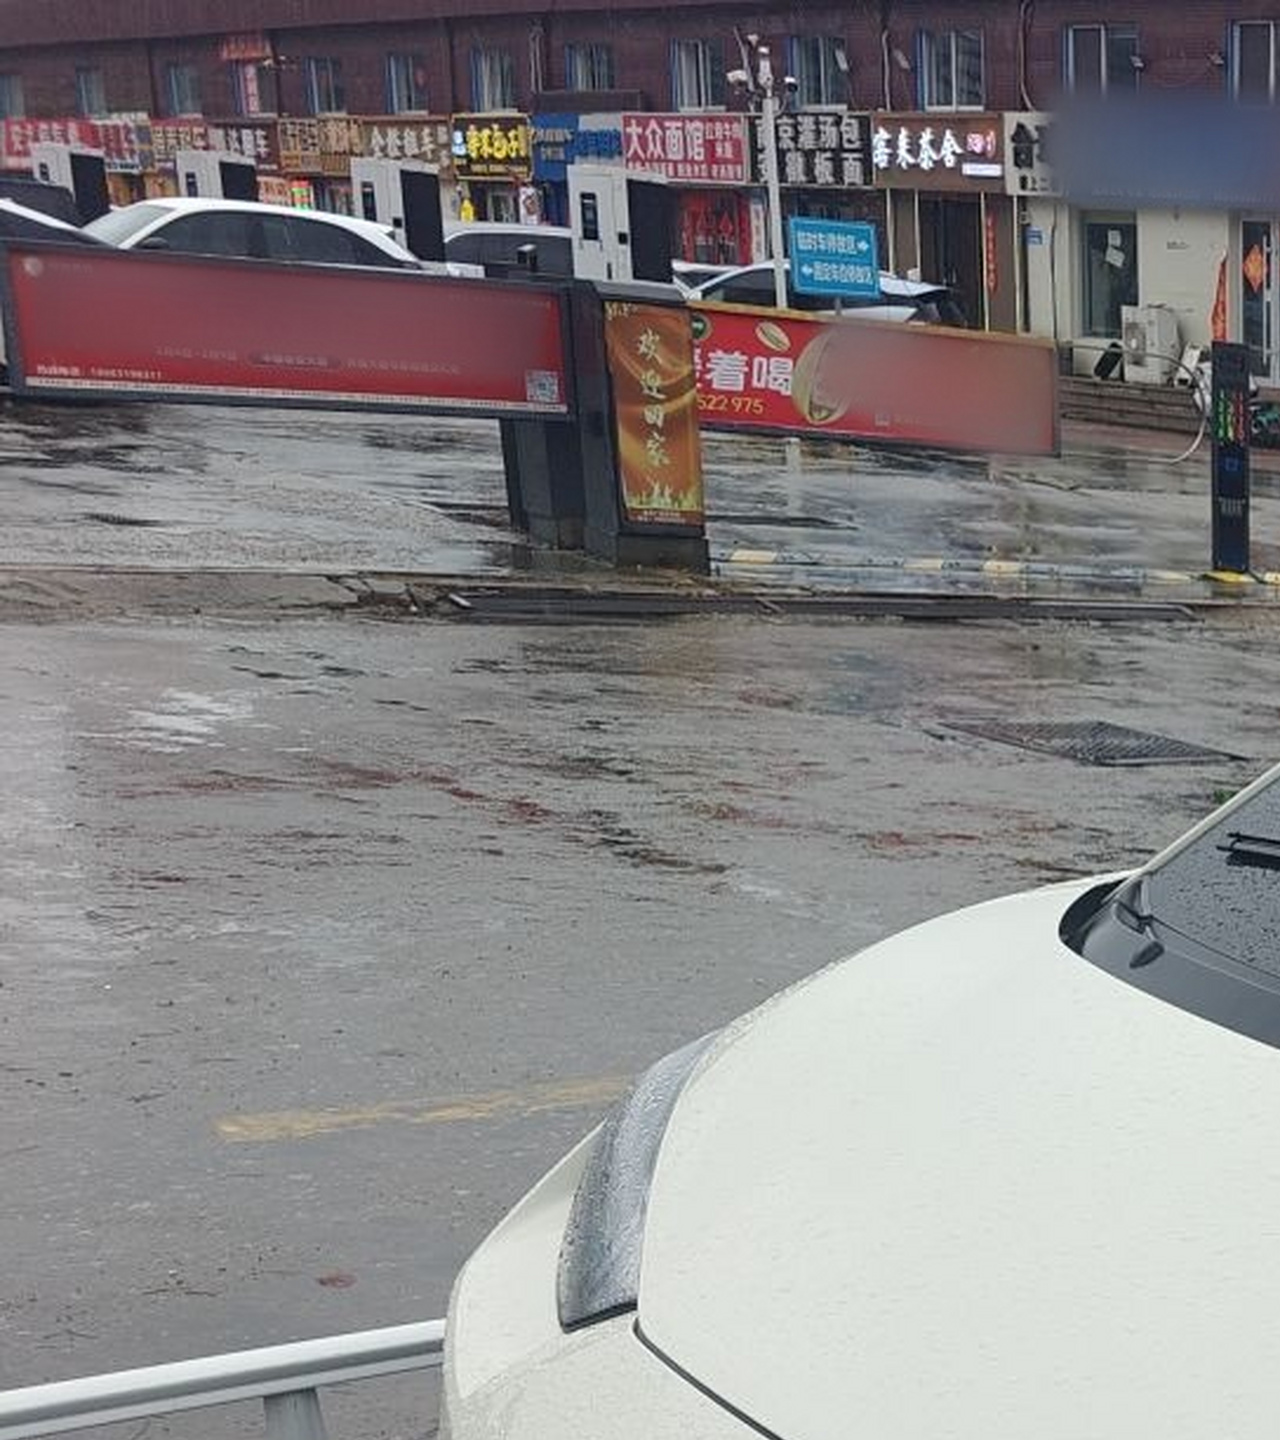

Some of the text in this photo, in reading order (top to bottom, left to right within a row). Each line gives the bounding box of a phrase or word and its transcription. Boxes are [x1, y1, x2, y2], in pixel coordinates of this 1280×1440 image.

[626, 118, 705, 161] 大众面馆
[693, 347, 796, 396] 着喝
